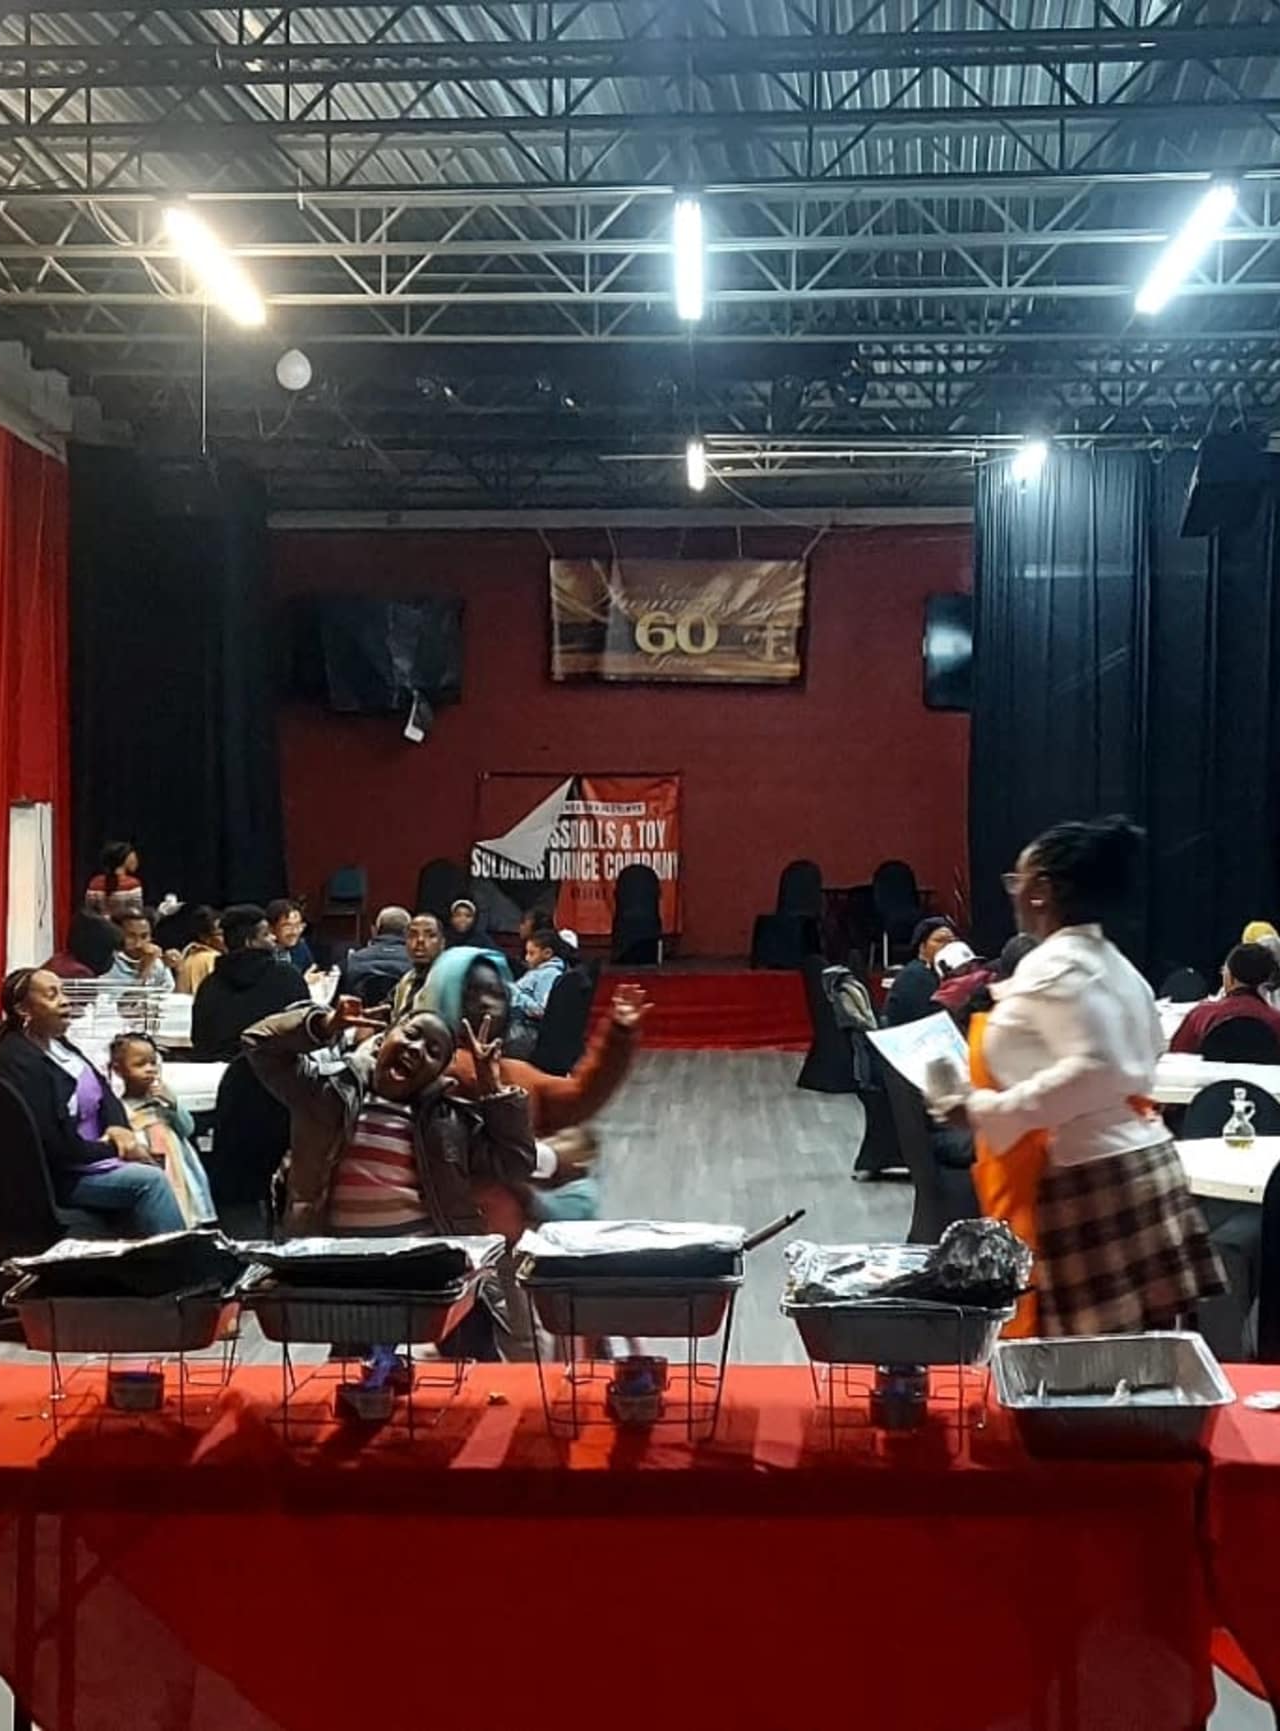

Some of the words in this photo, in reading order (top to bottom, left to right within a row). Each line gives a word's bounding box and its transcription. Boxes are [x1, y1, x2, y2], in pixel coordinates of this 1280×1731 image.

[635, 611, 720, 655] 60
[550, 819, 616, 849] SSDOLLS
[620, 823, 632, 849] &
[637, 819, 667, 850] TOY
[549, 851, 600, 881] DANCE
